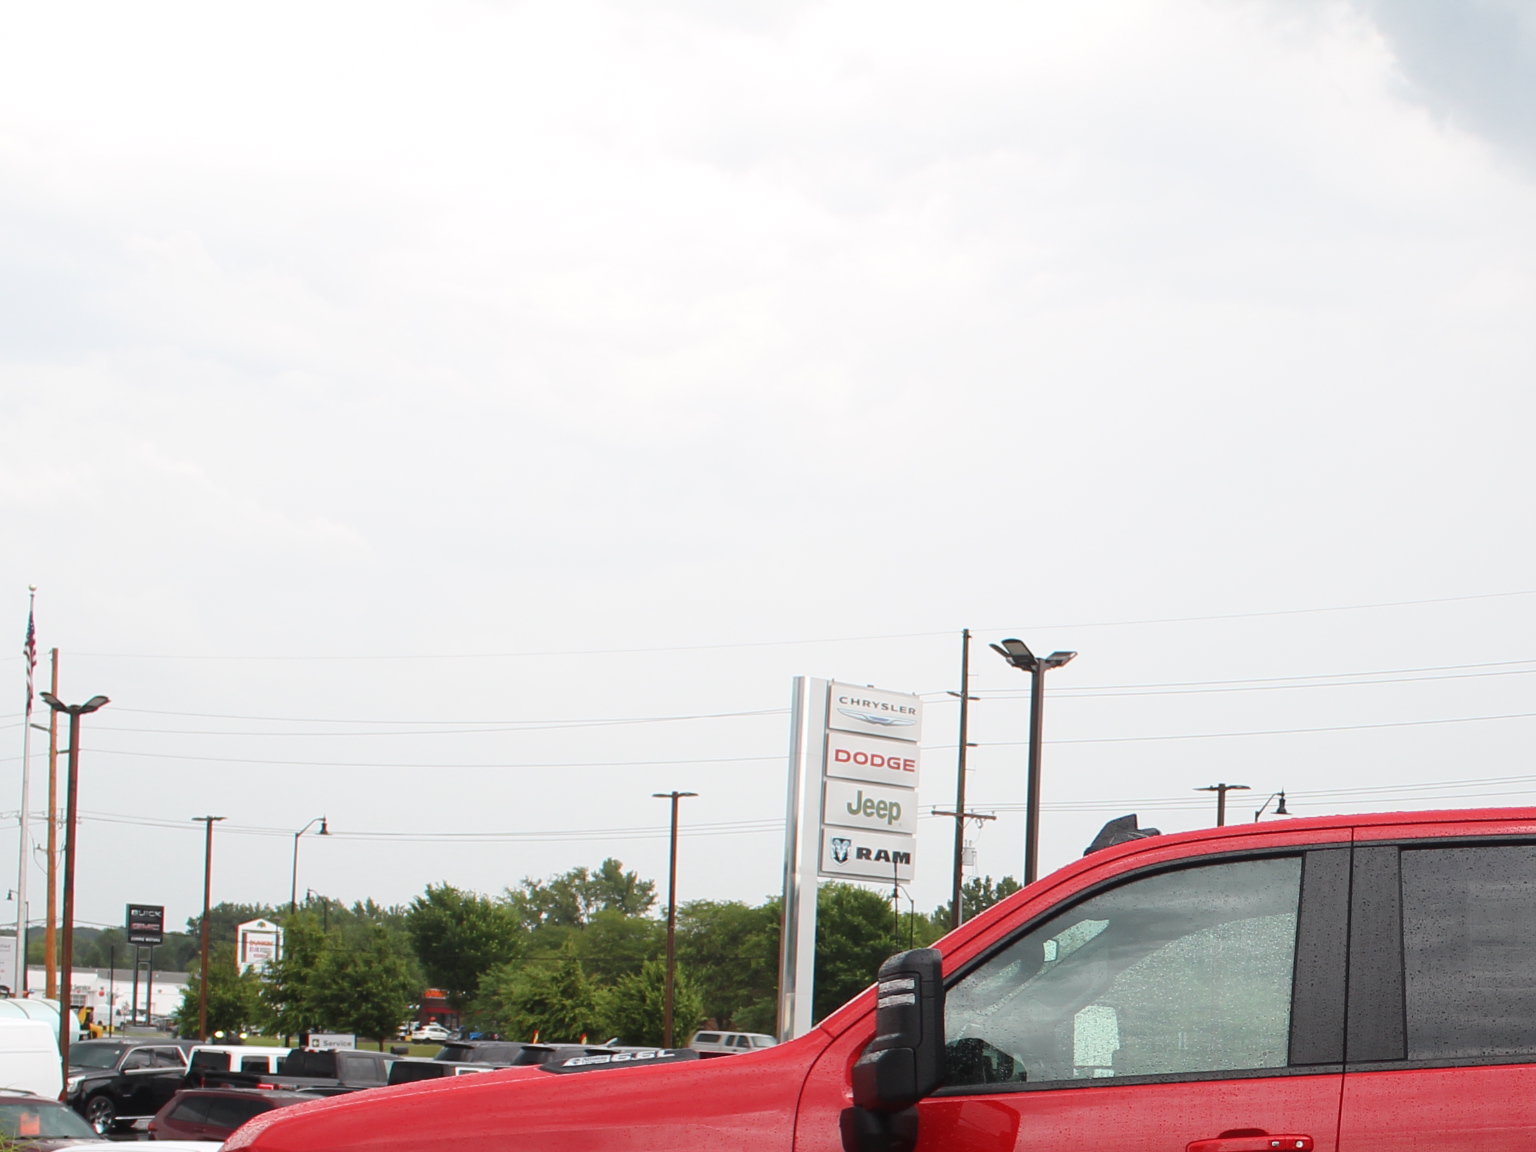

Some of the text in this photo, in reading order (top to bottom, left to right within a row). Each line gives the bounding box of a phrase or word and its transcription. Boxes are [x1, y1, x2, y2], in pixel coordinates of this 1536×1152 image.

[839, 696, 916, 715] CHRYSLER
[834, 749, 916, 772] DODGE
[846, 790, 902, 825] Jeep
[855, 846, 911, 865] RAM
[131, 909, 162, 918] BUICK
